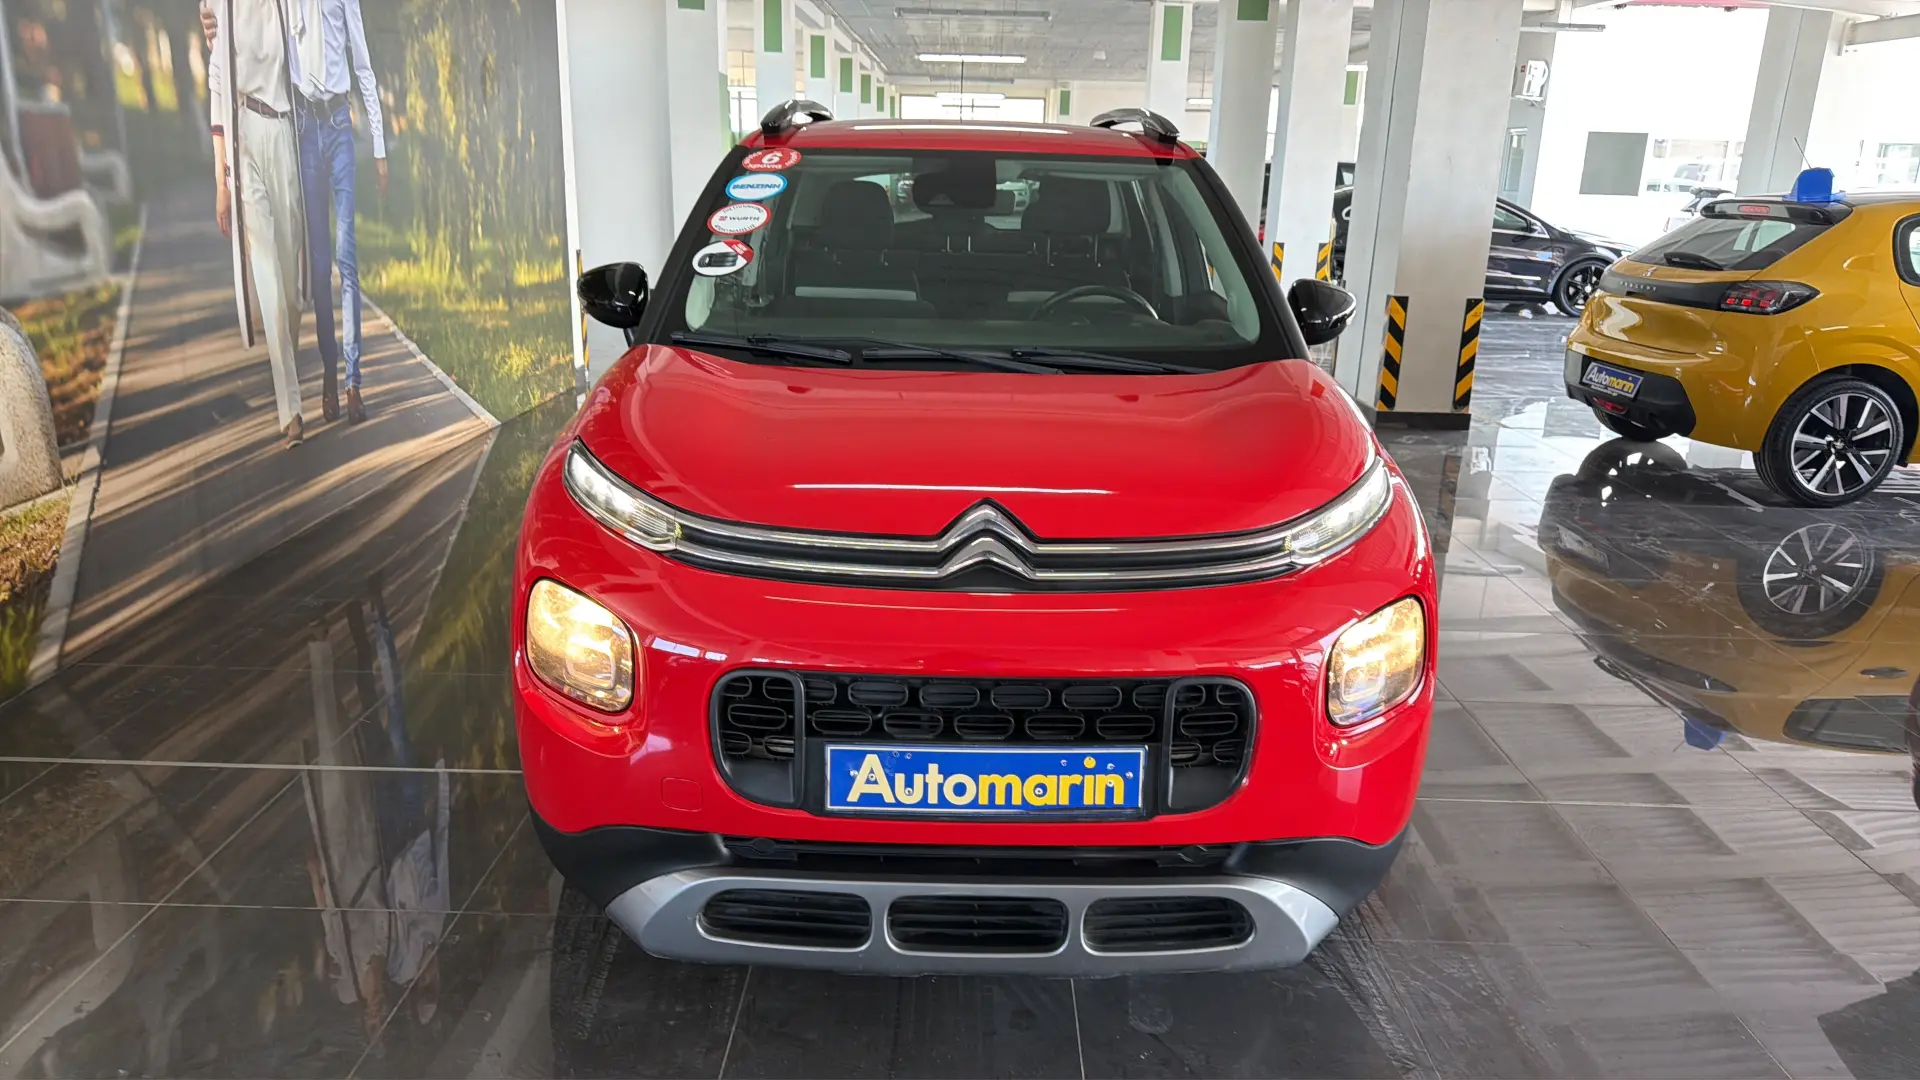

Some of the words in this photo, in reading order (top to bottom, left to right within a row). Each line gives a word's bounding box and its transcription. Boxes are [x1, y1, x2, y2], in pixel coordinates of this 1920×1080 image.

[761, 151, 784, 164] 6
[1586, 366, 1635, 393] Automarin
[846, 753, 1125, 806] Automarin
